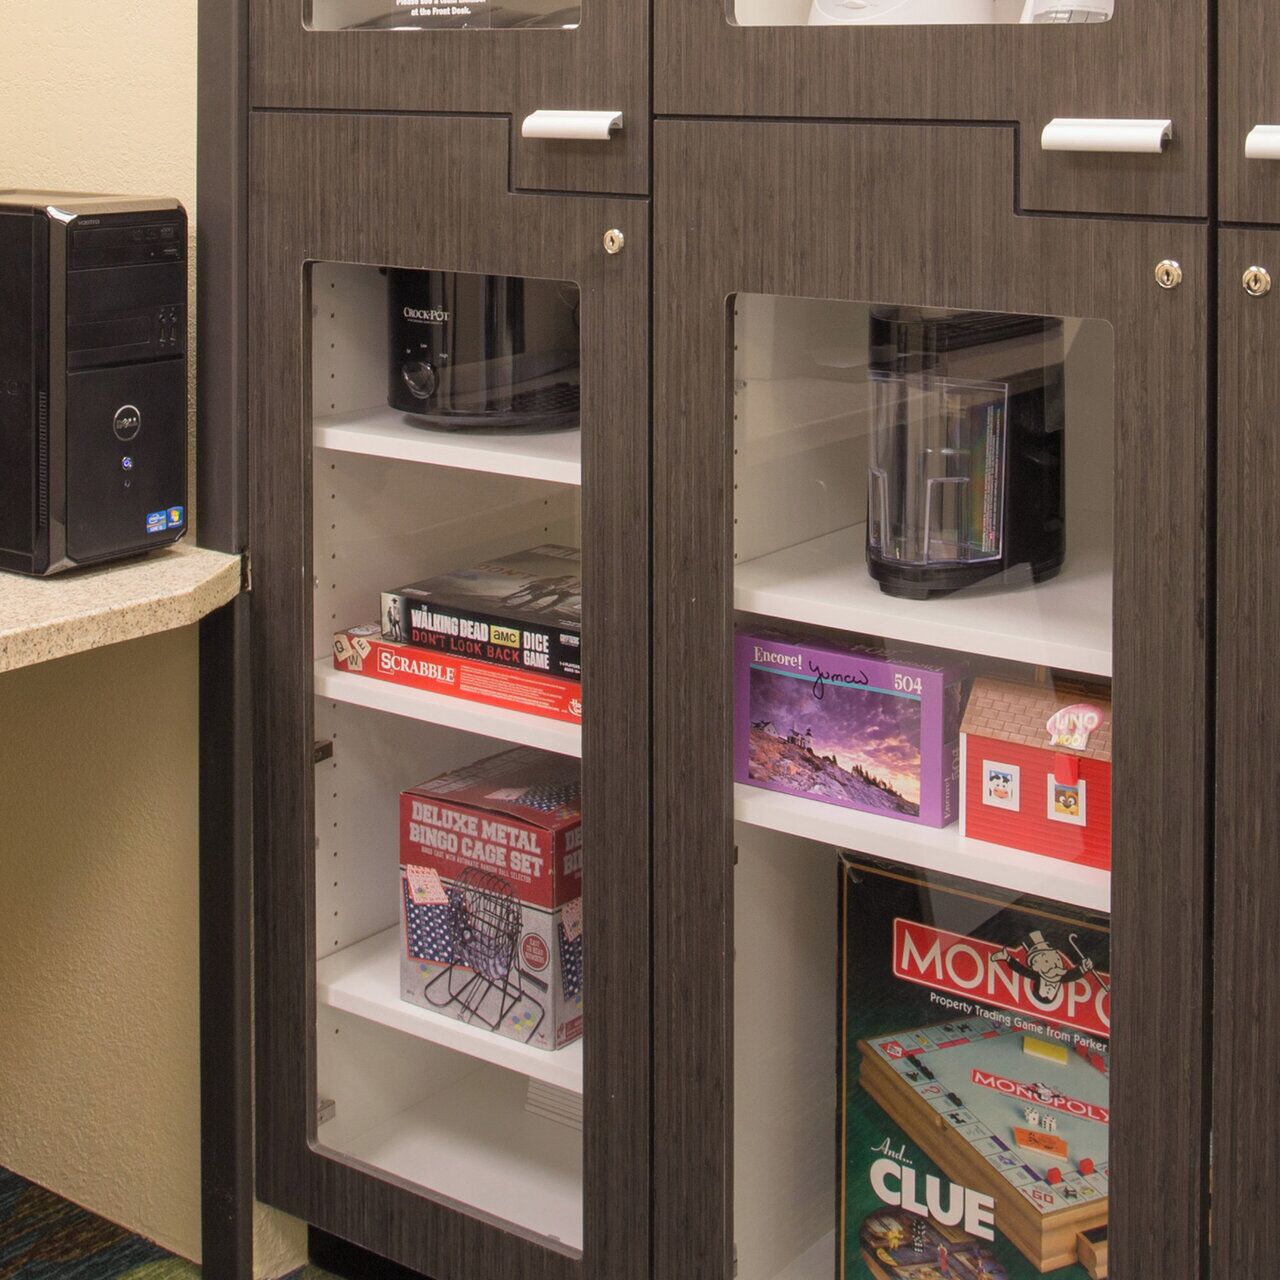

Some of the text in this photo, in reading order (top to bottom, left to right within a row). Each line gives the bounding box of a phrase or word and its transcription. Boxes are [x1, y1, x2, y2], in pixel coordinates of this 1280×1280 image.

[420, 7, 431, 16] the
[432, 6, 450, 15] Front
[411, 609, 458, 636] WALKING
[460, 618, 488, 642] DEAD
[412, 629, 520, 663] DON'T LOOK BACK
[523, 631, 549, 653] DICE
[381, 652, 455, 682] SCRABBLE
[523, 650, 549, 670] GAME
[754, 646, 802, 670] Encore!
[894, 673, 923, 695] 504
[1055, 711, 1098, 730] UNO
[412, 800, 479, 837] DELUXE
[481, 819, 541, 854] METAL
[410, 821, 458, 853] BINGO
[461, 837, 507, 869] CAGE
[510, 850, 543, 878] SET
[930, 992, 1108, 1053] Property Trading Game from Parker
[870, 1158, 995, 1242] CLUE
[1032, 1189, 1054, 1205] GO
